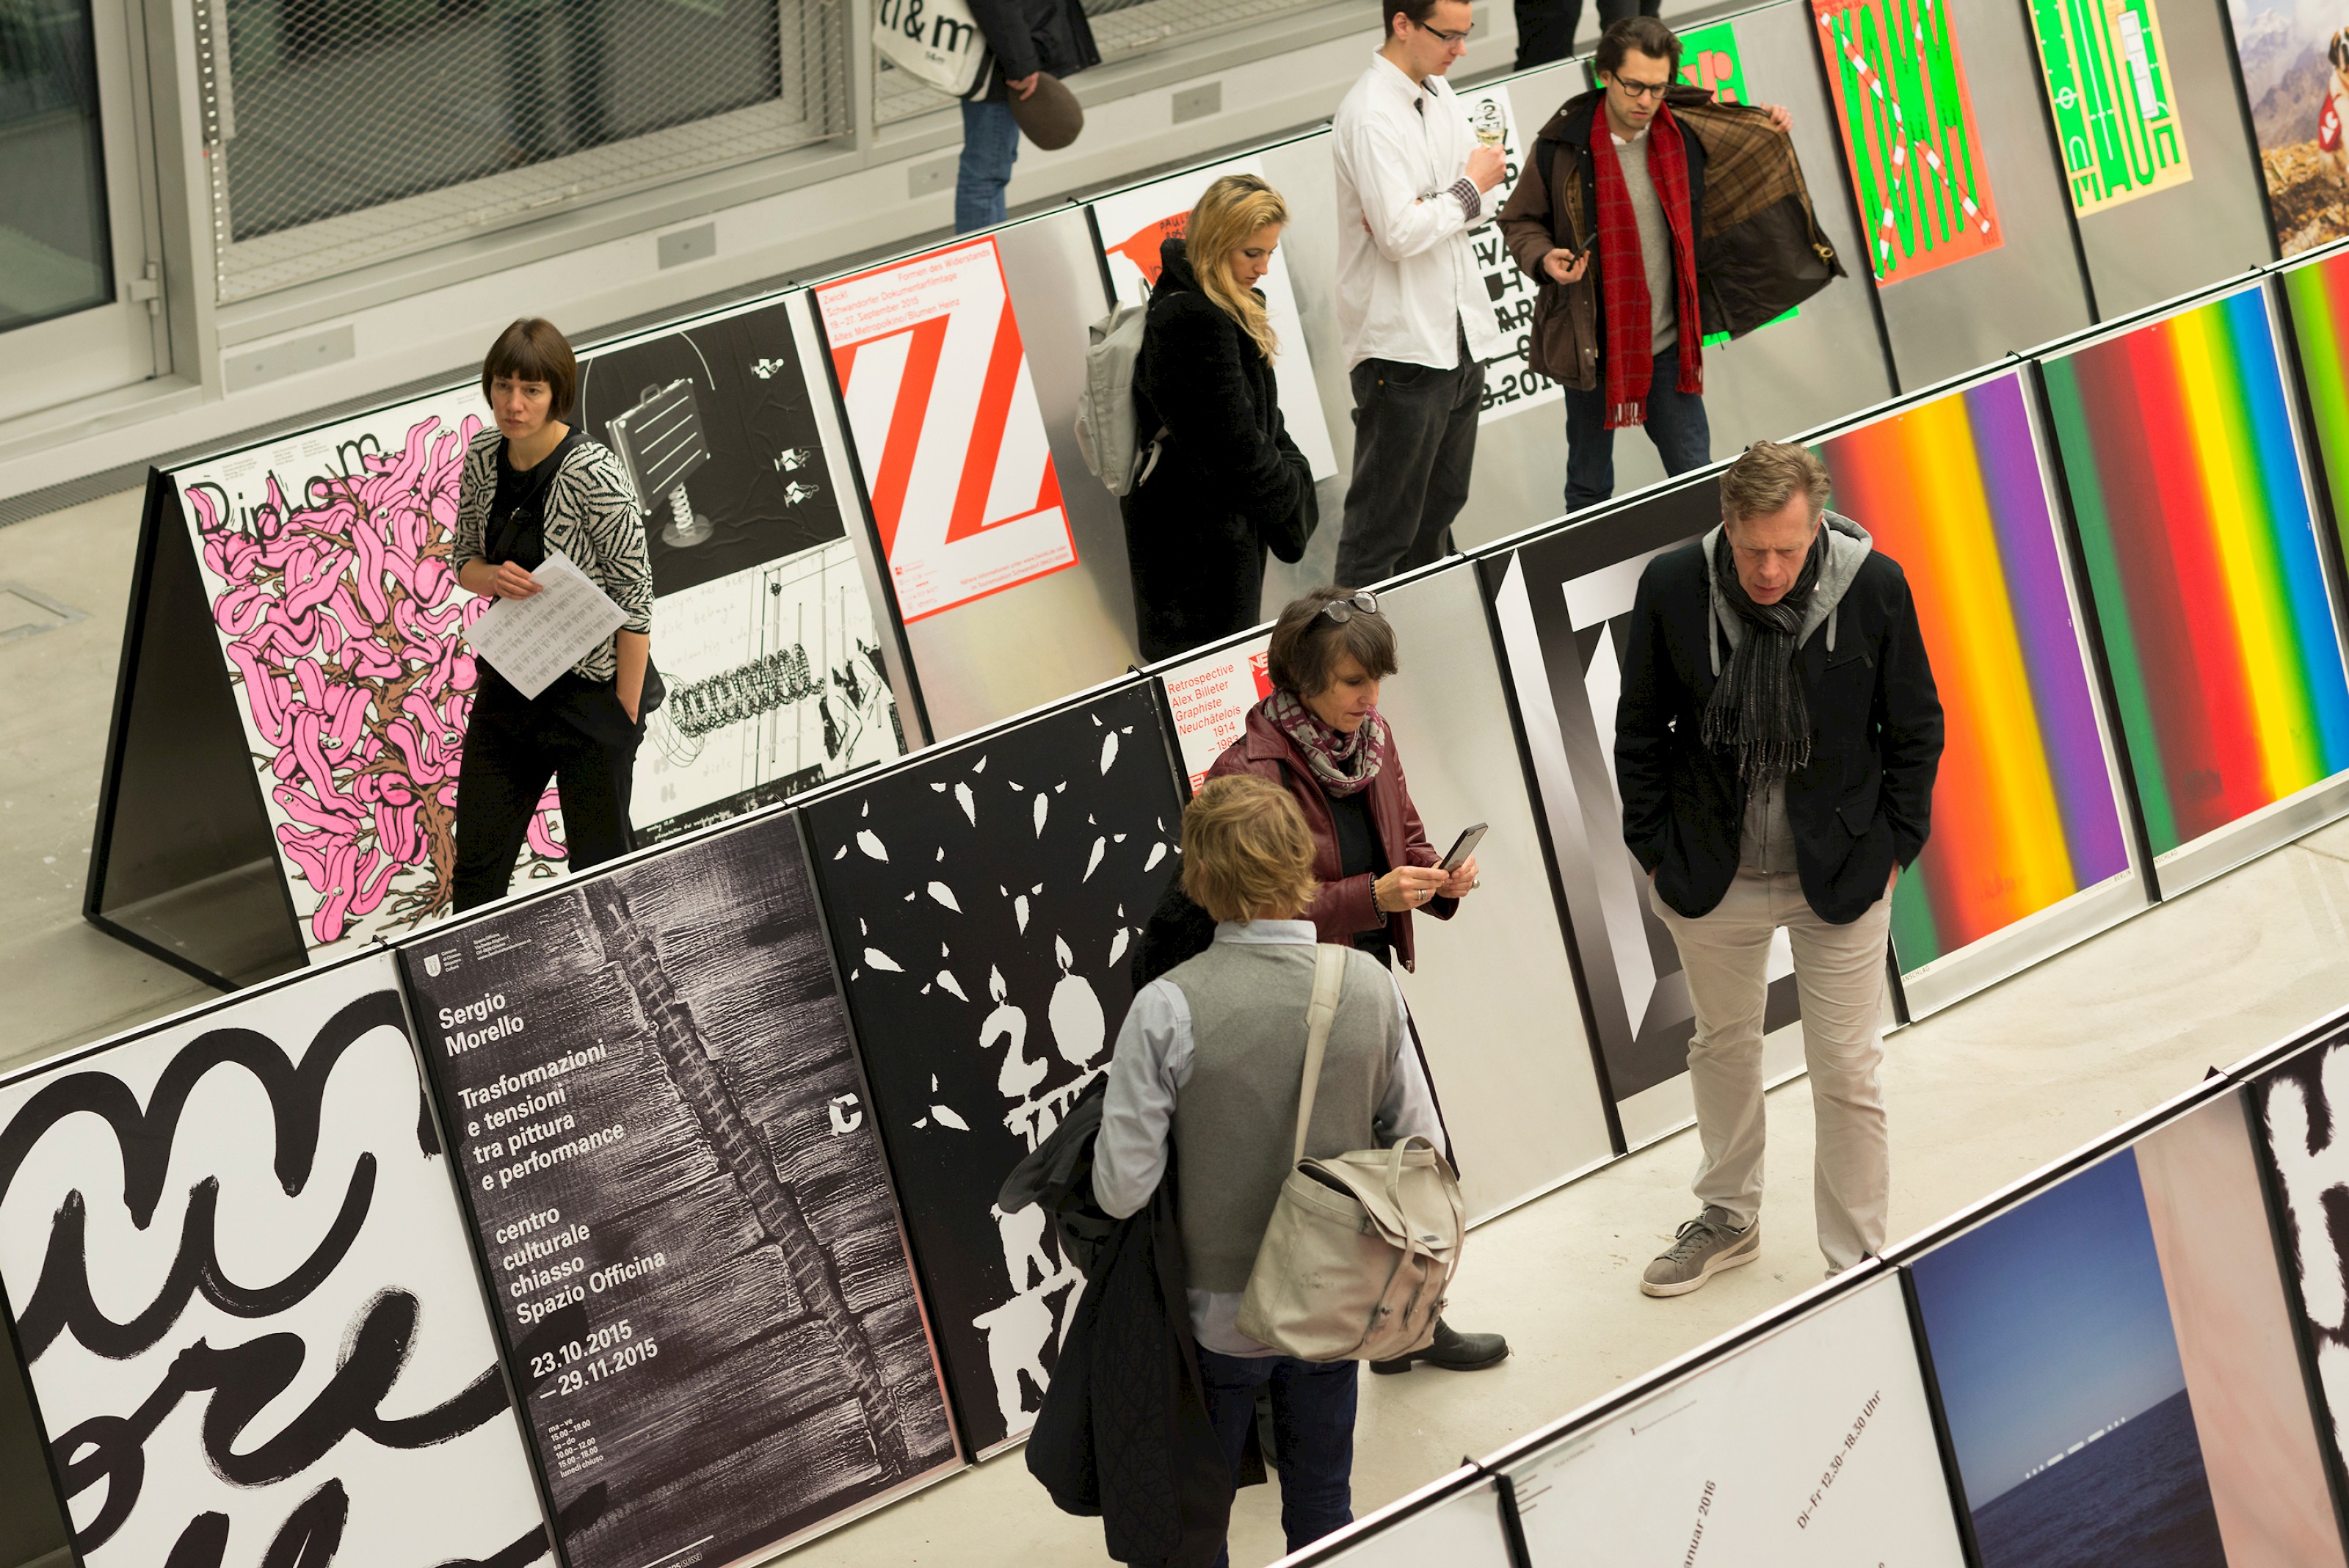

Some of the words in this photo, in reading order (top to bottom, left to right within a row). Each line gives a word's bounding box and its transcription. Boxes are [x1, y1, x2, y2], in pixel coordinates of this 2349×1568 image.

[898, 266, 927, 282] Formen
[929, 264, 943, 273] des
[945, 248, 990, 266] Widerstands
[827, 296, 879, 317] Schwandorfer
[881, 272, 958, 302] Dokumentarfilmtage
[859, 302, 900, 322] September
[901, 297, 919, 309] 2015
[834, 332, 853, 343] Altes
[939, 299, 960, 313] Heinz
[1167, 664, 1234, 694] Retrospective
[1172, 694, 1193, 708] Alex
[1195, 680, 1229, 700] Billeter
[1175, 698, 1222, 722] Graphiste
[1213, 721, 1236, 737] 1914
[439, 992, 505, 1028] Sergio
[446, 1015, 524, 1056] Morello
[458, 1039, 607, 1108] Trasformazioni
[468, 1120, 481, 1137] e
[483, 1084, 567, 1130] tensioni
[473, 1141, 504, 1164] tra
[507, 1112, 576, 1155] pittura
[482, 1174, 494, 1191] e
[499, 1123, 624, 1188] performance
[495, 1208, 559, 1244] centro
[503, 1224, 590, 1271] culturale
[510, 1257, 584, 1297] chiasso
[516, 1285, 585, 1324] Spazio
[589, 1252, 666, 1293] Officina
[530, 1319, 632, 1378] 23.10.2015
[1863, 1390, 1881, 1417] Uhr
[581, 1454, 603, 1468] chiuso
[1698, 1480, 1716, 1517] 2016
